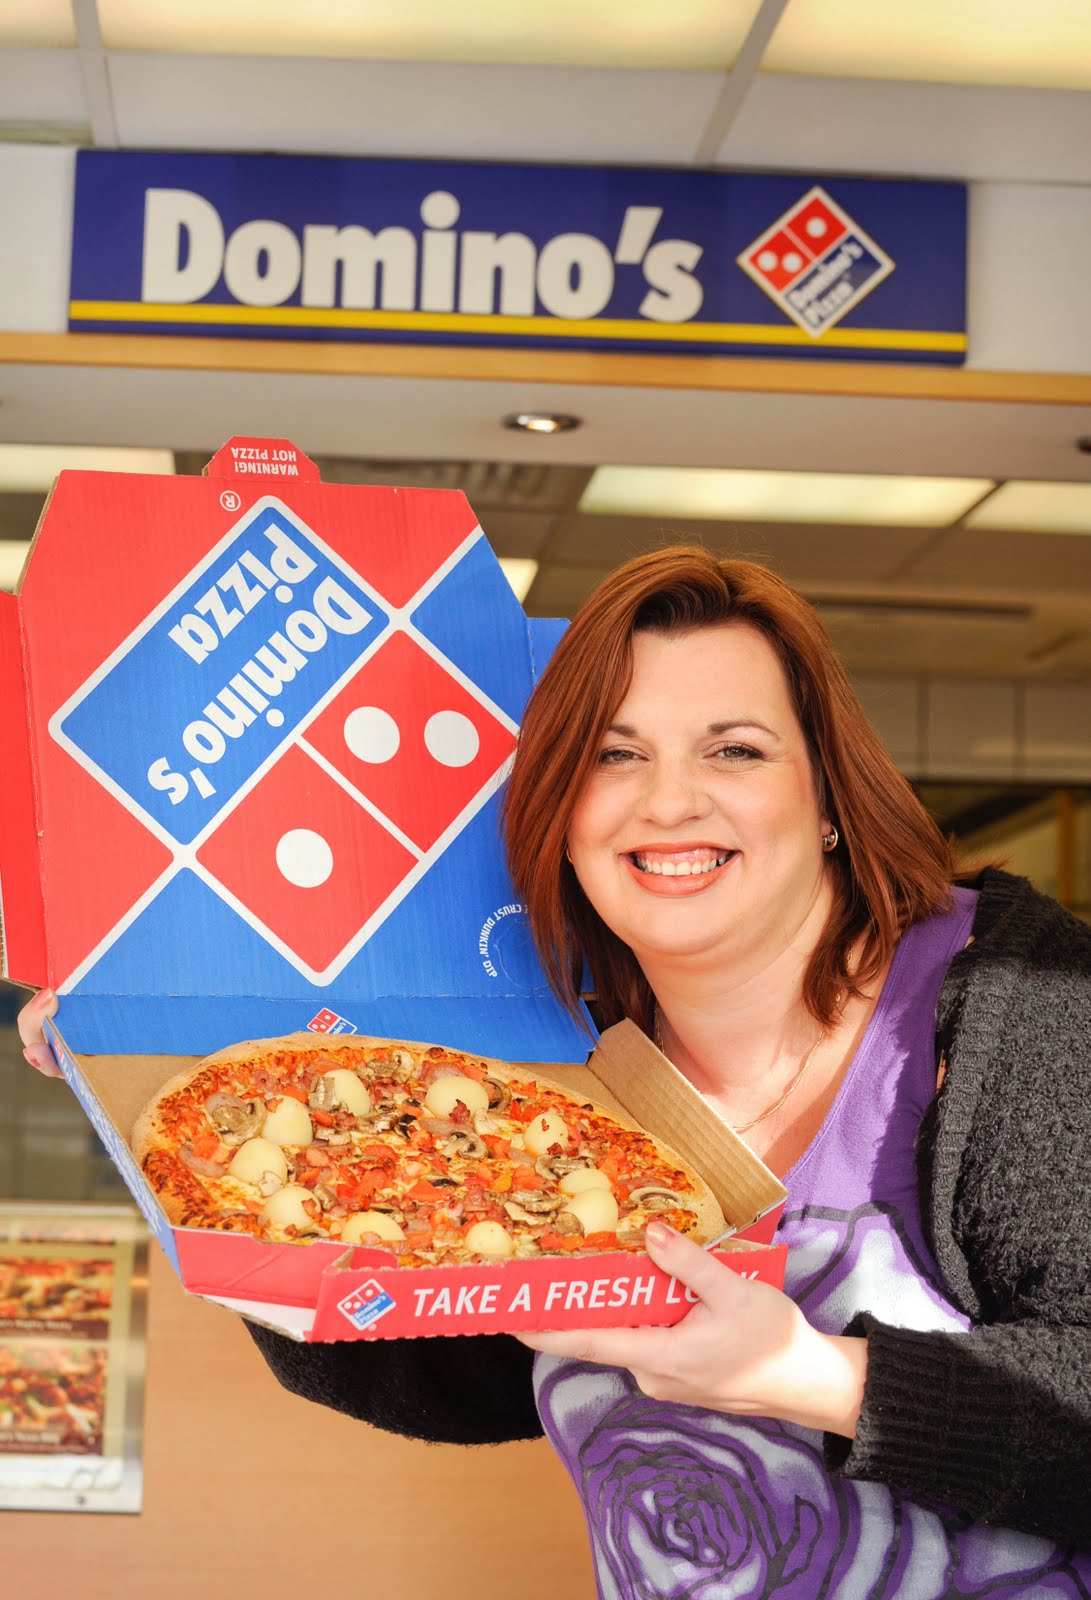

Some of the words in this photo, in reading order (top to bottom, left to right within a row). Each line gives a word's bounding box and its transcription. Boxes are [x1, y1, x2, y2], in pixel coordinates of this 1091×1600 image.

[141, 188, 703, 322] Domino's
[788, 242, 864, 308] Domino's
[230, 447, 269, 460] PIZZA
[233, 461, 299, 476] WARNING!
[271, 449, 297, 462] HOT
[167, 523, 318, 665] Pizza
[147, 575, 374, 806] Domino's
[493, 904, 522, 921] CRUST
[479, 917, 496, 958] DUNKIN'
[482, 960, 498, 977] DIP
[412, 1284, 501, 1317] TAKE
[508, 1283, 532, 1313] A
[544, 1276, 656, 1312] FRESH
